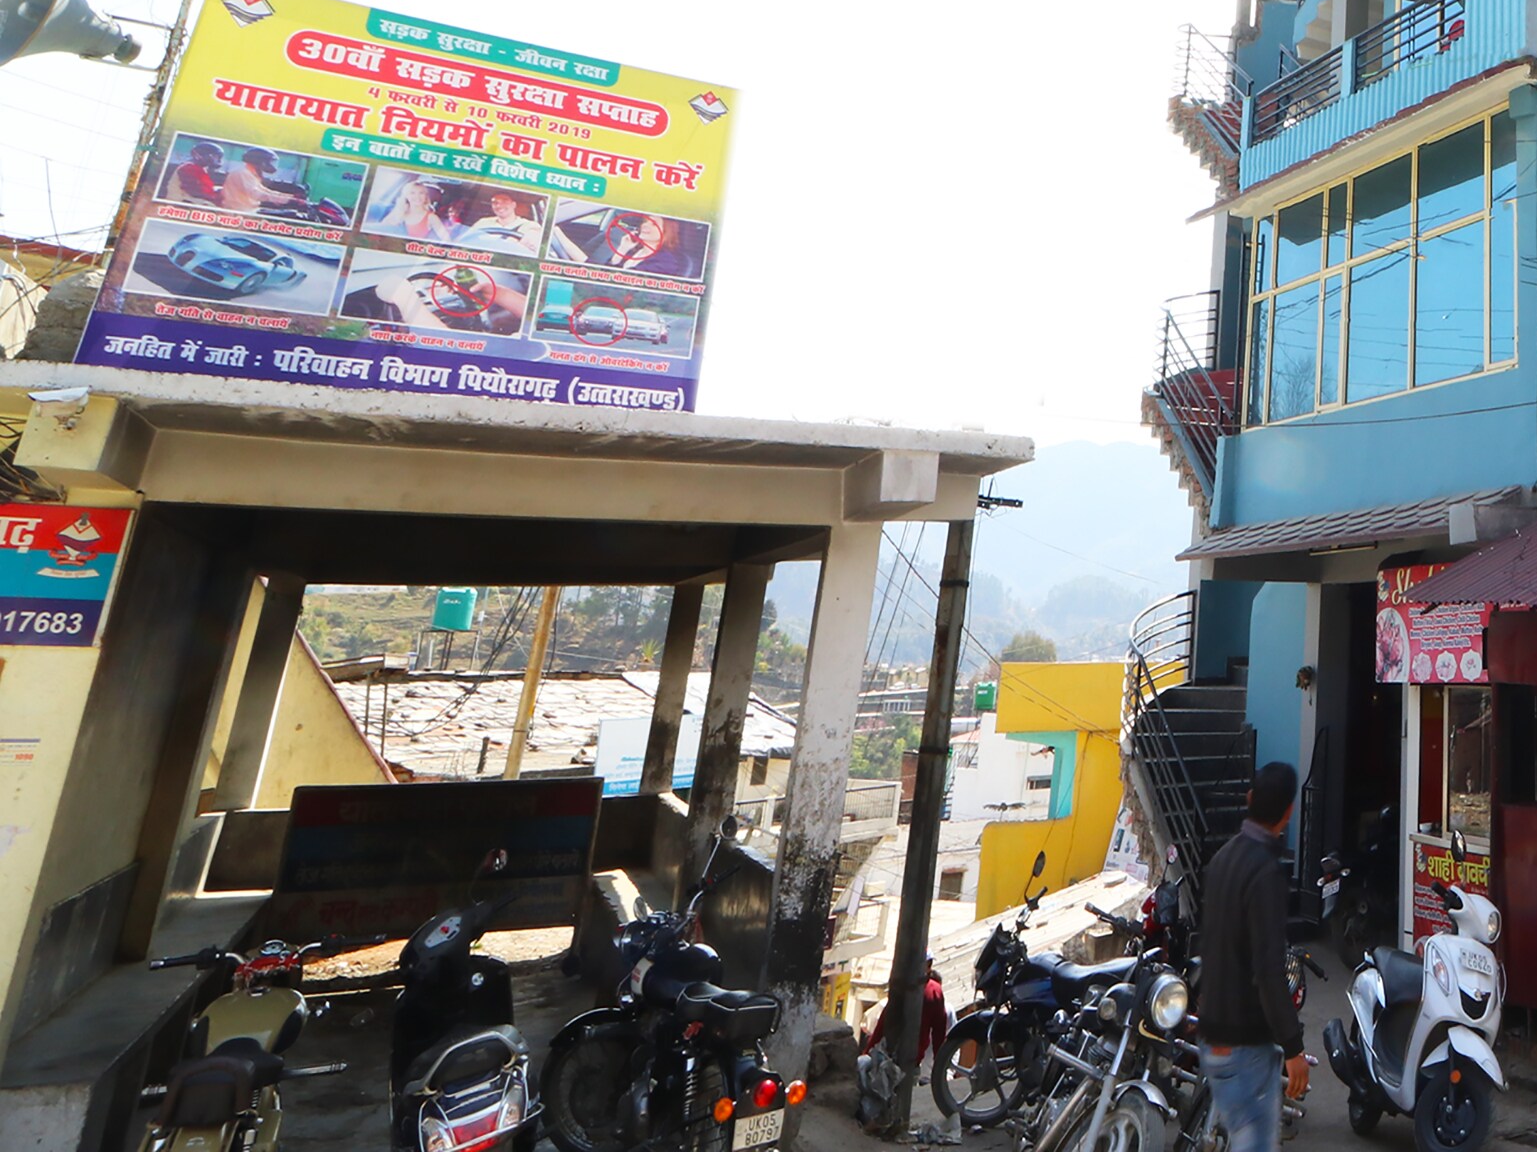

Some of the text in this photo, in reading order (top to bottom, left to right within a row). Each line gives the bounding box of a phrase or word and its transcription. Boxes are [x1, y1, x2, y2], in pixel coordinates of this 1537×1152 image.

[379, 18, 431, 41] सड़क
[437, 32, 492, 55] सुरक्षा
[514, 48, 569, 72] जीवन
[573, 62, 609, 81] रक्षा
[388, 89, 438, 110] फरवरी
[443, 99, 459, 114] से
[468, 106, 487, 119] 10
[496, 110, 543, 130] फरवरी
[549, 122, 591, 140] 2019
[395, 57, 476, 88] सड़क
[485, 74, 569, 109] सुरक्षा
[576, 94, 660, 128] सप्ताह
[213, 79, 704, 190] यातायात नियमों का पालन करें
[332, 133, 362, 152] इन
[369, 142, 416, 161] बातों
[418, 150, 446, 166] का
[452, 154, 489, 174] रखें
[490, 157, 541, 183] विशेष
[545, 172, 588, 192] ध्यान
[158, 206, 187, 220] हमेशा
[191, 211, 214, 223] BIS
[244, 219, 259, 229] का
[155, 302, 176, 315] तेज
[179, 304, 200, 319] गति
[203, 307, 214, 320] से
[216, 311, 243, 323] वाहन
[247, 315, 256, 325] न
[104, 334, 176, 361] जनहित
[180, 340, 203, 363] में
[204, 344, 250, 368] जारी
[272, 346, 374, 381] परिवाहन
[378, 355, 452, 390] विभाग
[0, 610, 84, 635] 17683
[1427, 850, 1455, 882] शाही
[748, 1113, 776, 1131] UK05
